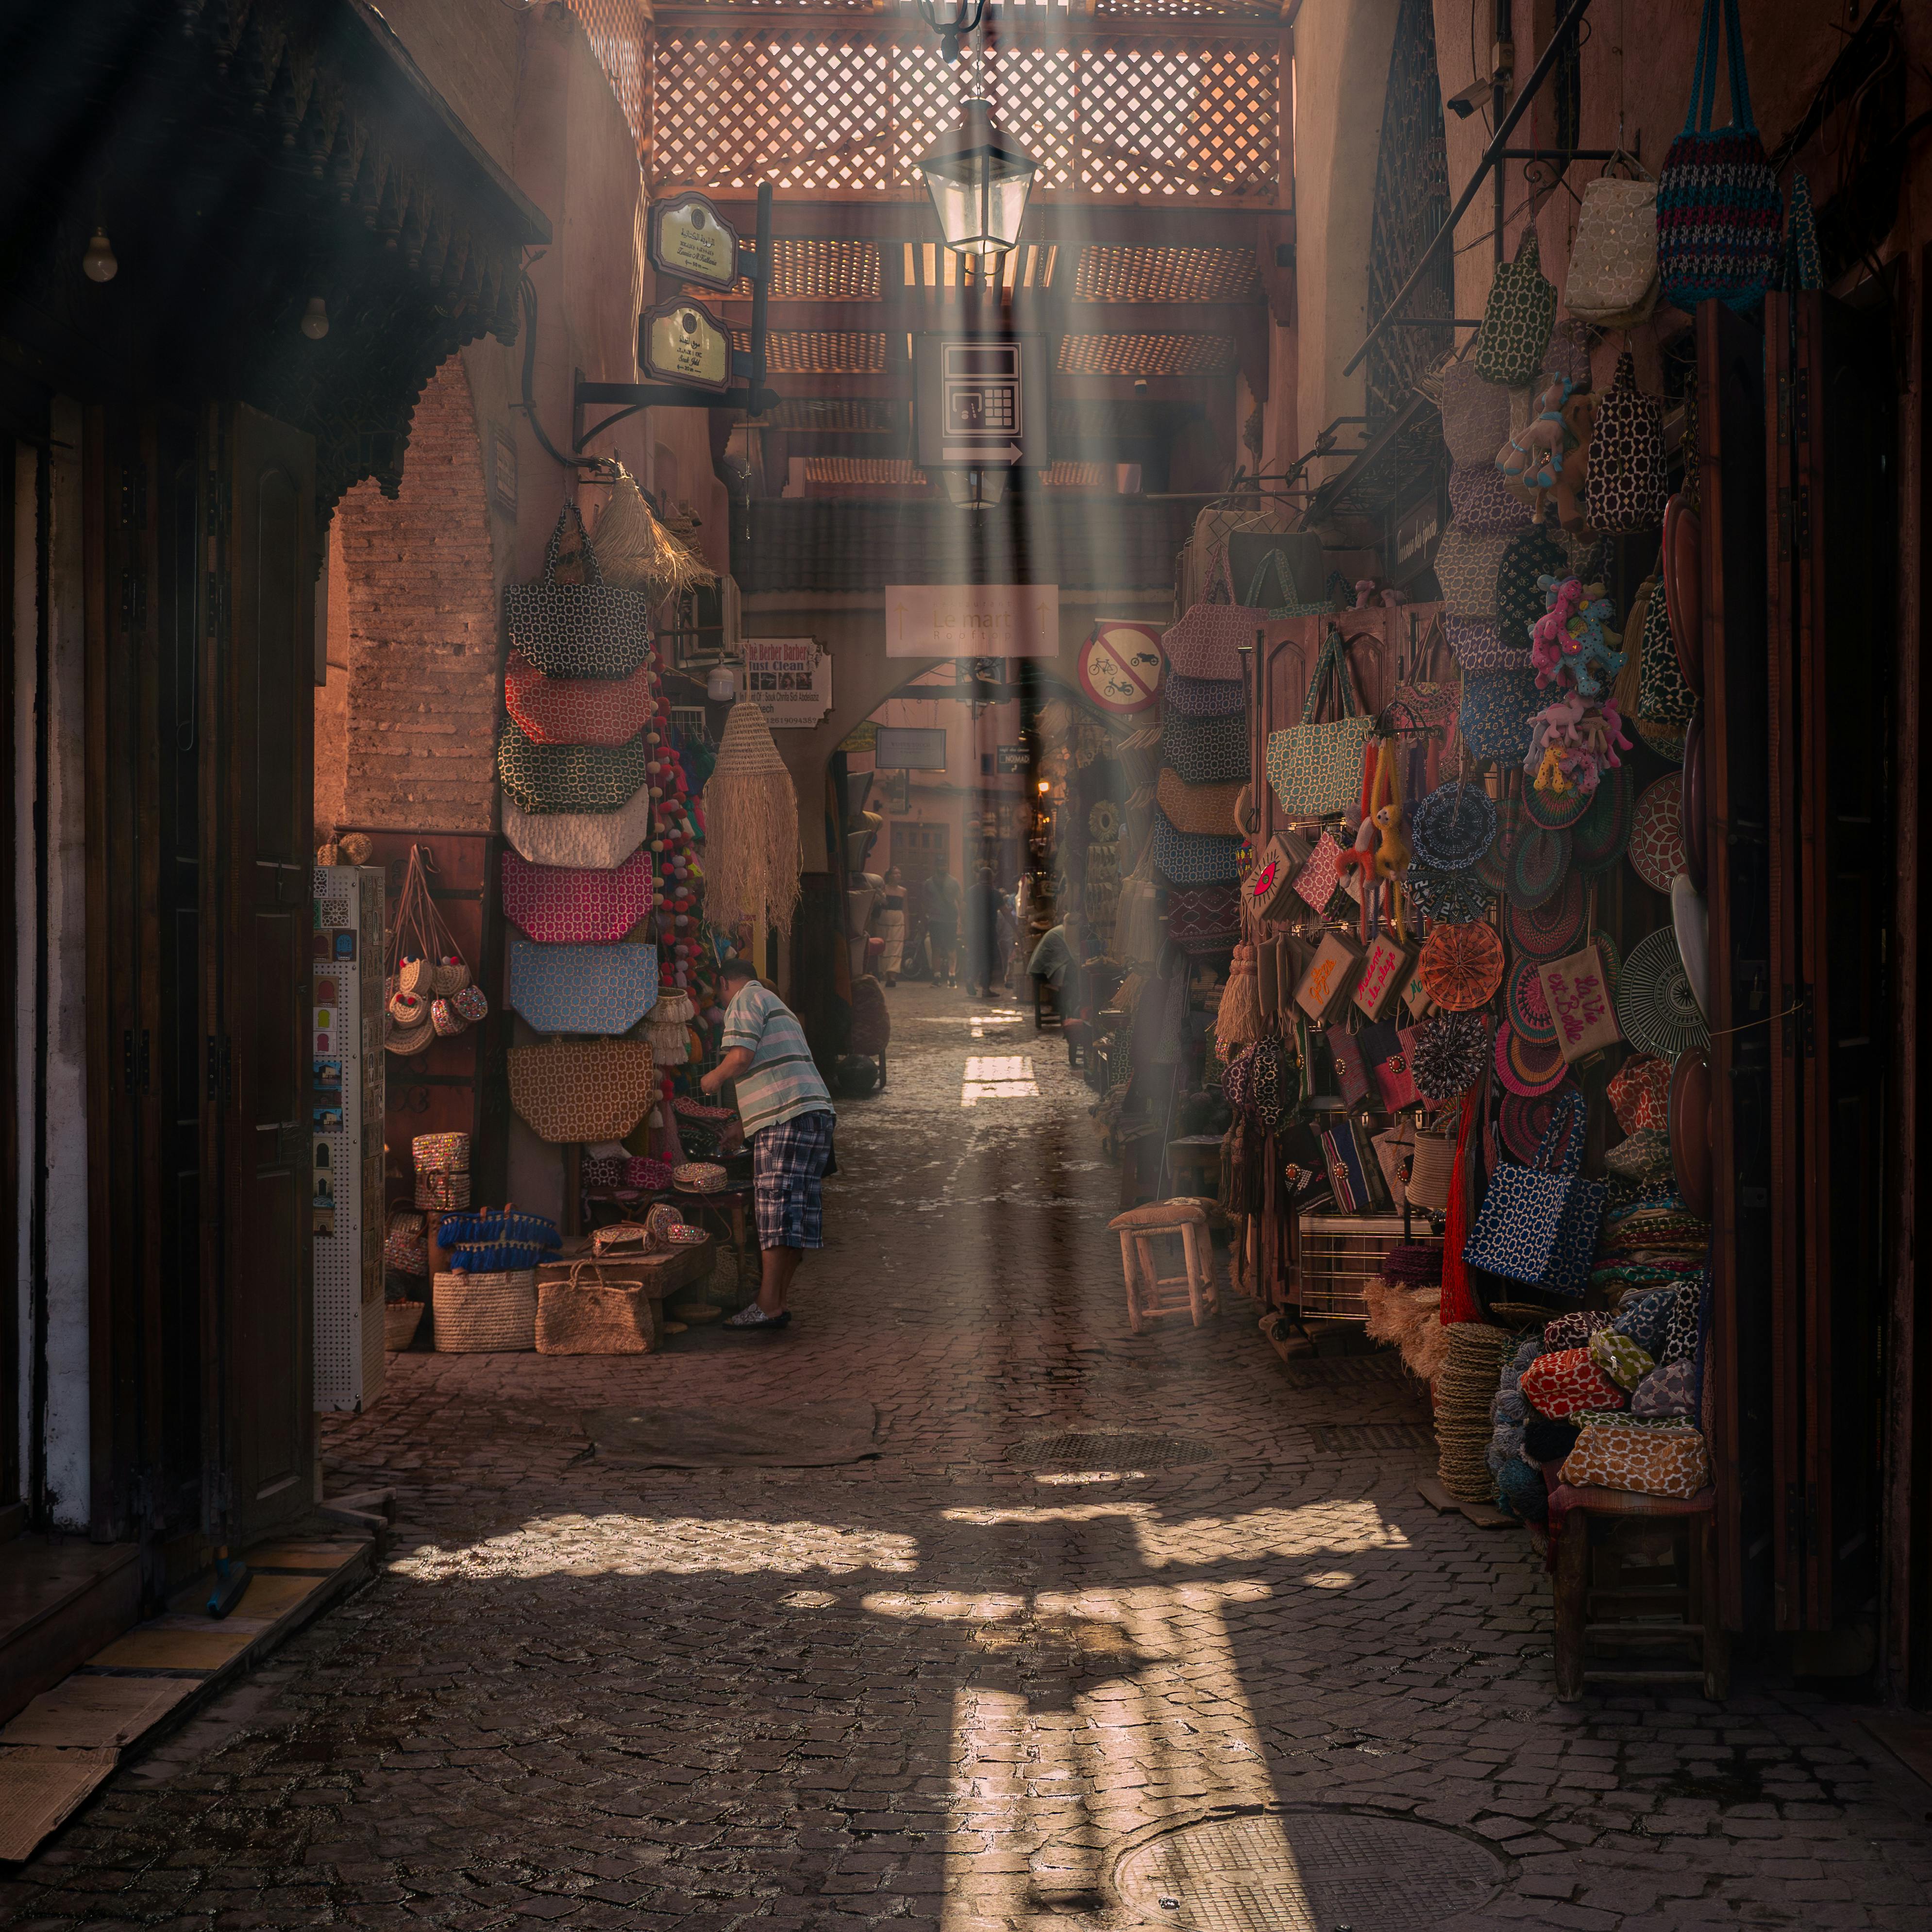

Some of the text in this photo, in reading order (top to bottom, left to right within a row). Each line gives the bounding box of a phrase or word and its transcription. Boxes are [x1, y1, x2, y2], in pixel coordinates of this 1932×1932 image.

[690, 340, 700, 349] سوق
[933, 610, 1010, 628] Le mart
[933, 630, 1011, 641] Rooftop
[759, 644, 782, 660] Berber
[783, 644, 807, 660] Barber
[773, 661, 804, 671] Clean
[765, 692, 775, 702] Souk
[1005, 754, 1030, 763] NOMAD
